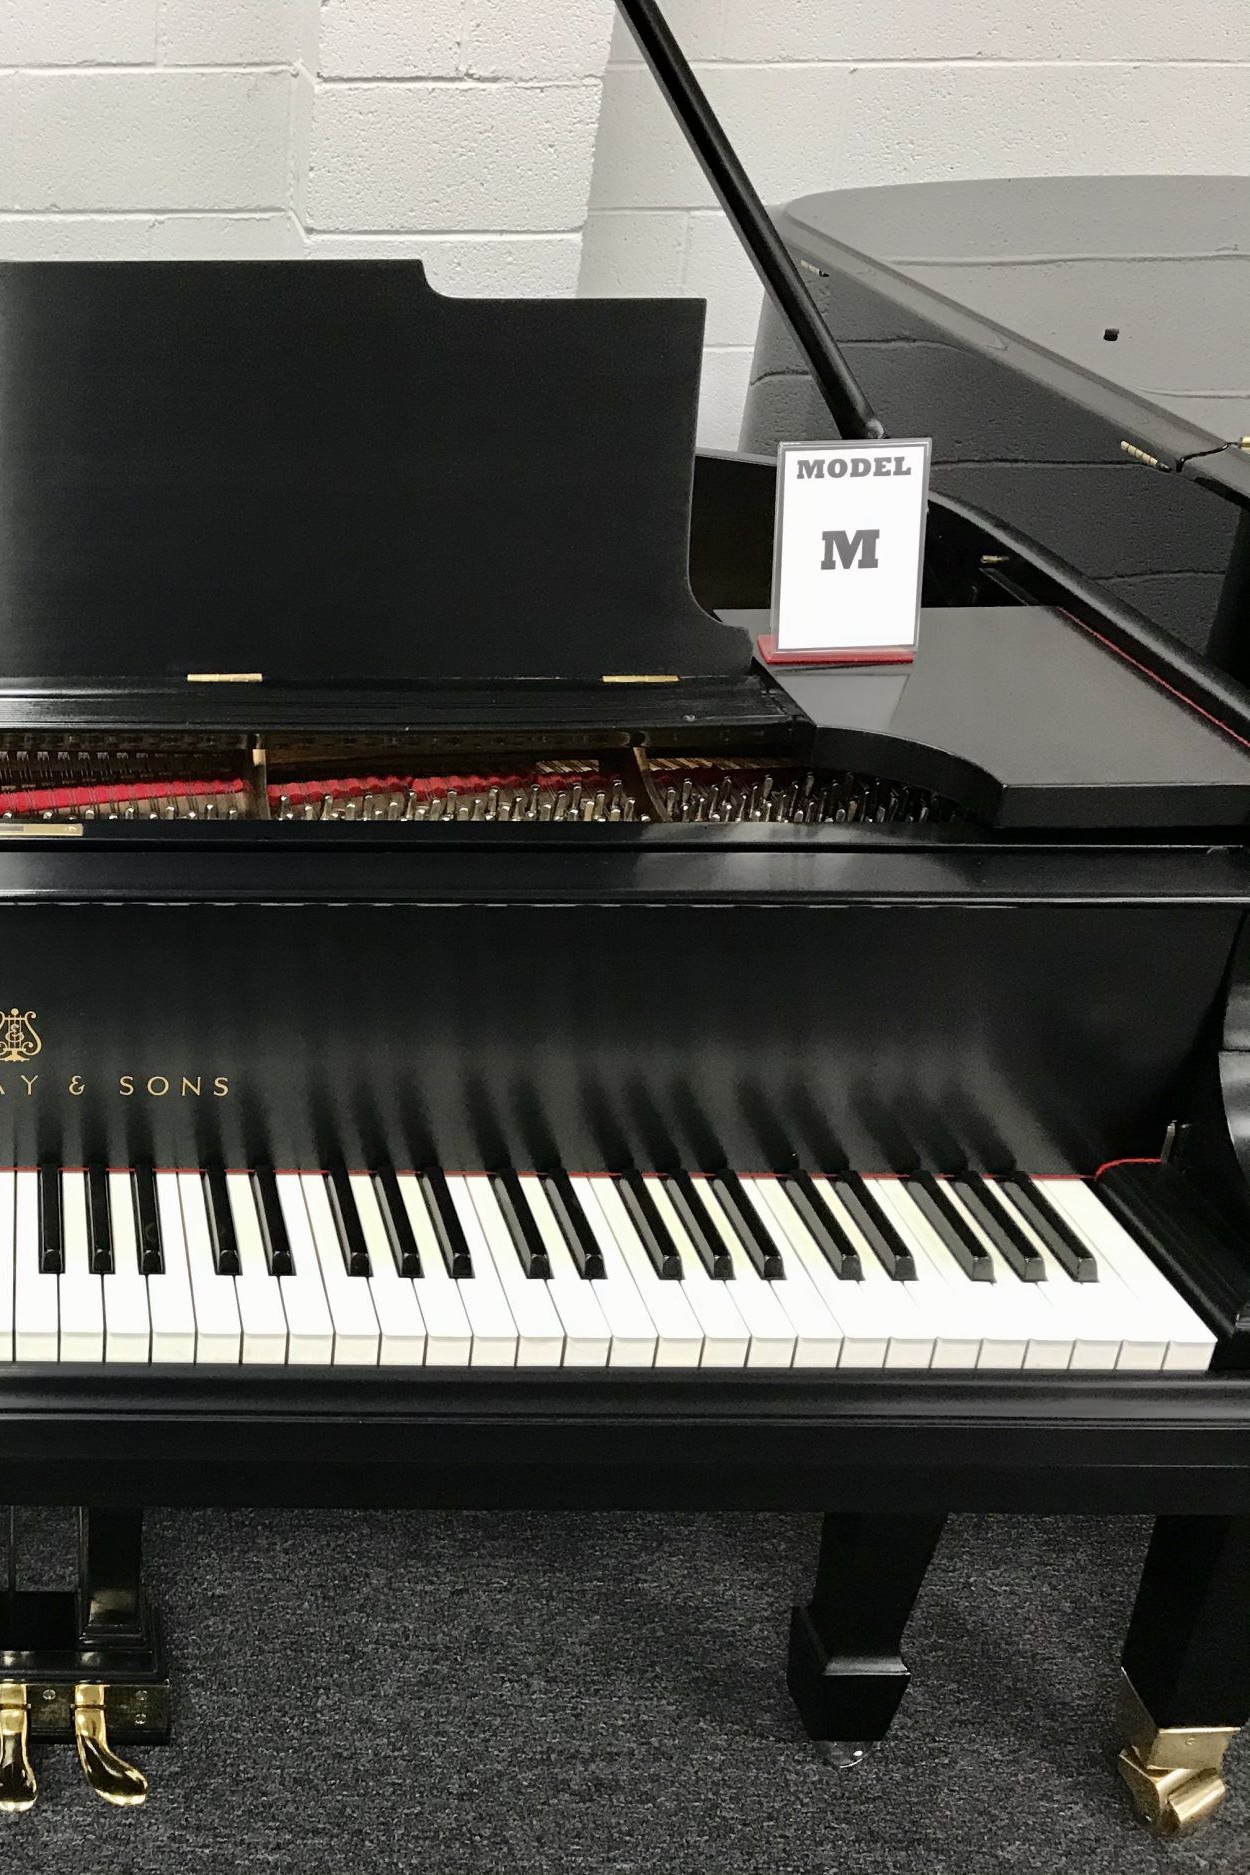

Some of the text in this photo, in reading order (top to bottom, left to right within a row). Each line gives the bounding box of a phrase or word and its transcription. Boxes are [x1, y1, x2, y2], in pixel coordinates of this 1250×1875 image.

[796, 457, 912, 479] MODEL
[821, 529, 880, 570] M
[68, 1075, 86, 1096] &
[119, 1075, 230, 1097] SONS
